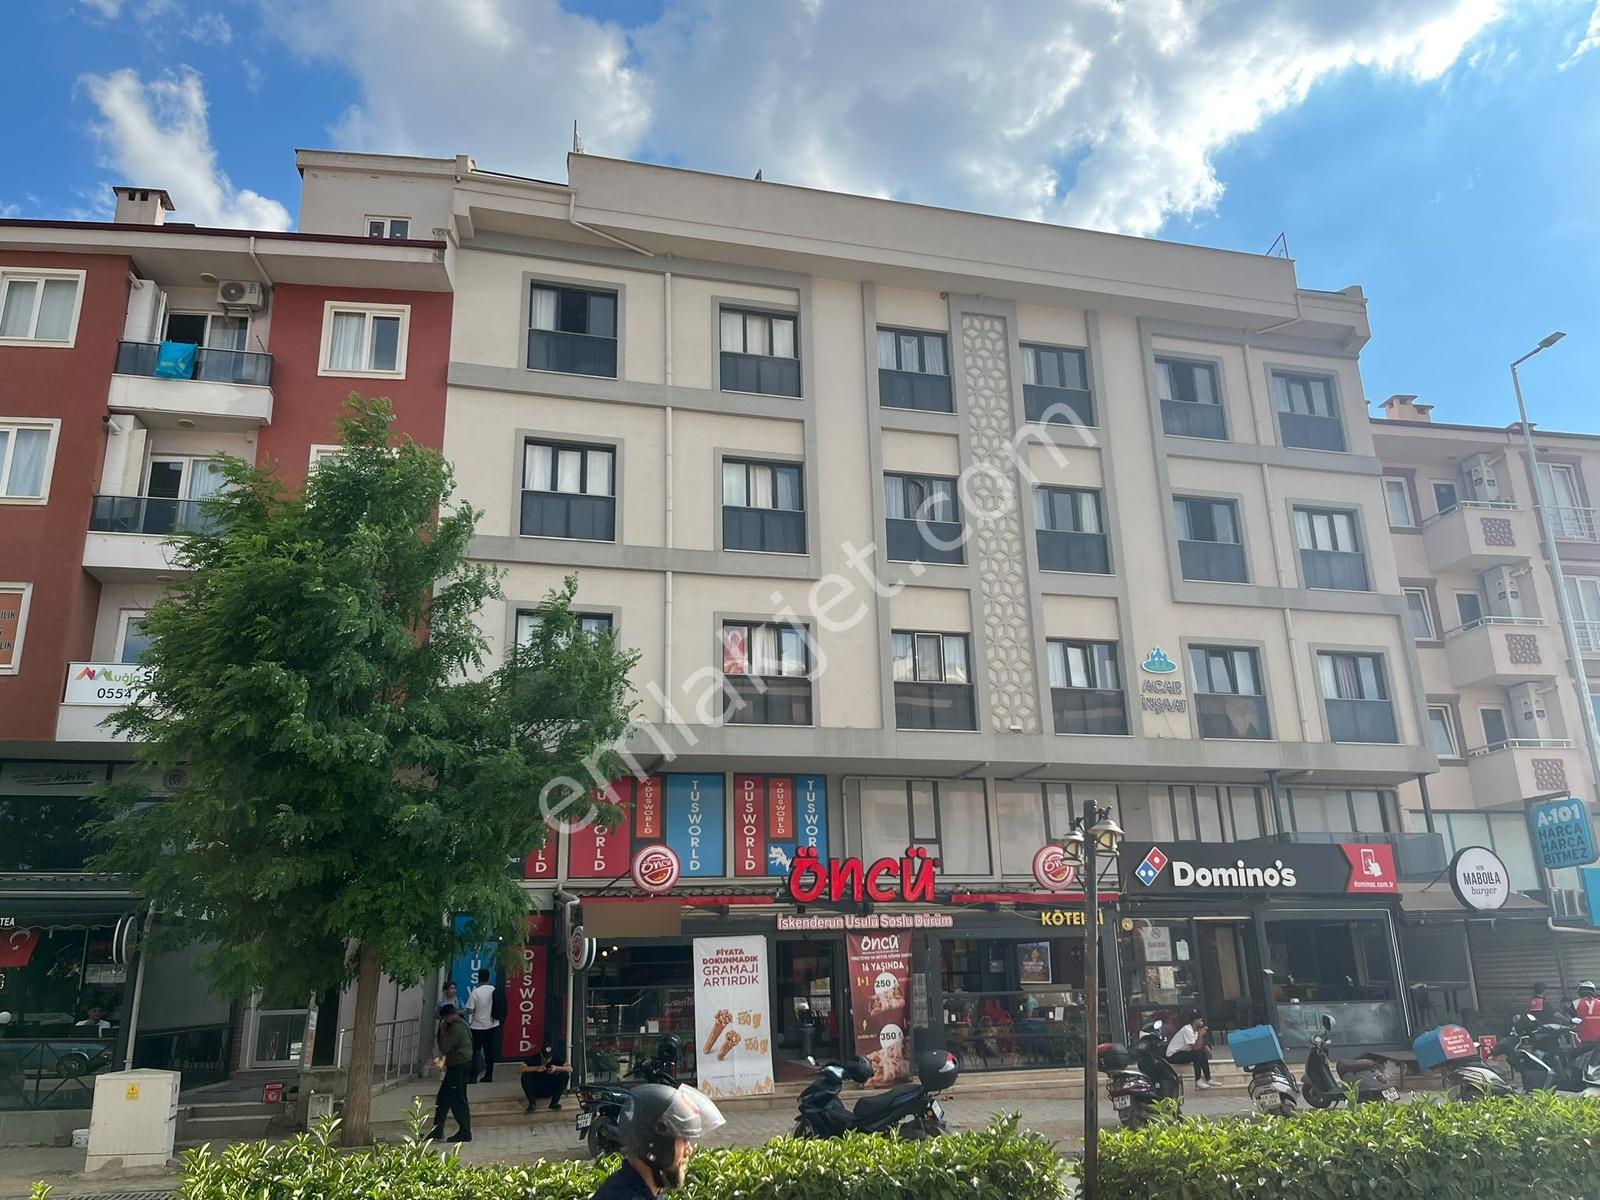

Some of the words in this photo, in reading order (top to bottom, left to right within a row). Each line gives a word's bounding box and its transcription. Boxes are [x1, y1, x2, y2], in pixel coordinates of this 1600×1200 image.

[776, 782, 786, 834] YDUSWORLD
[805, 780, 818, 848] TUSWOR
[688, 780, 702, 870] TUSWORLD
[743, 780, 757, 870] DUSWORLD
[1538, 822, 1584, 841] HARCA
[1541, 835, 1586, 853] HARCA
[1172, 860, 1297, 887] Domino's
[1463, 871, 1501, 885] MABOLLA
[1471, 886, 1497, 896] burger
[777, 914, 843, 929] İskenderun
[845, 914, 879, 928] Usulü
[880, 914, 913, 927] Soslu
[914, 913, 953, 927] Dürüm
[716, 948, 744, 956] FİYATA
[702, 956, 758, 965] DOKUNMADIK
[862, 963, 870, 972] 16
[871, 961, 904, 973] YAŞINDA
[703, 964, 759, 976] GRAMAJI
[703, 976, 759, 987] ARTIRDIK
[875, 980, 891, 988] 250
[880, 1032, 896, 1040] 350
